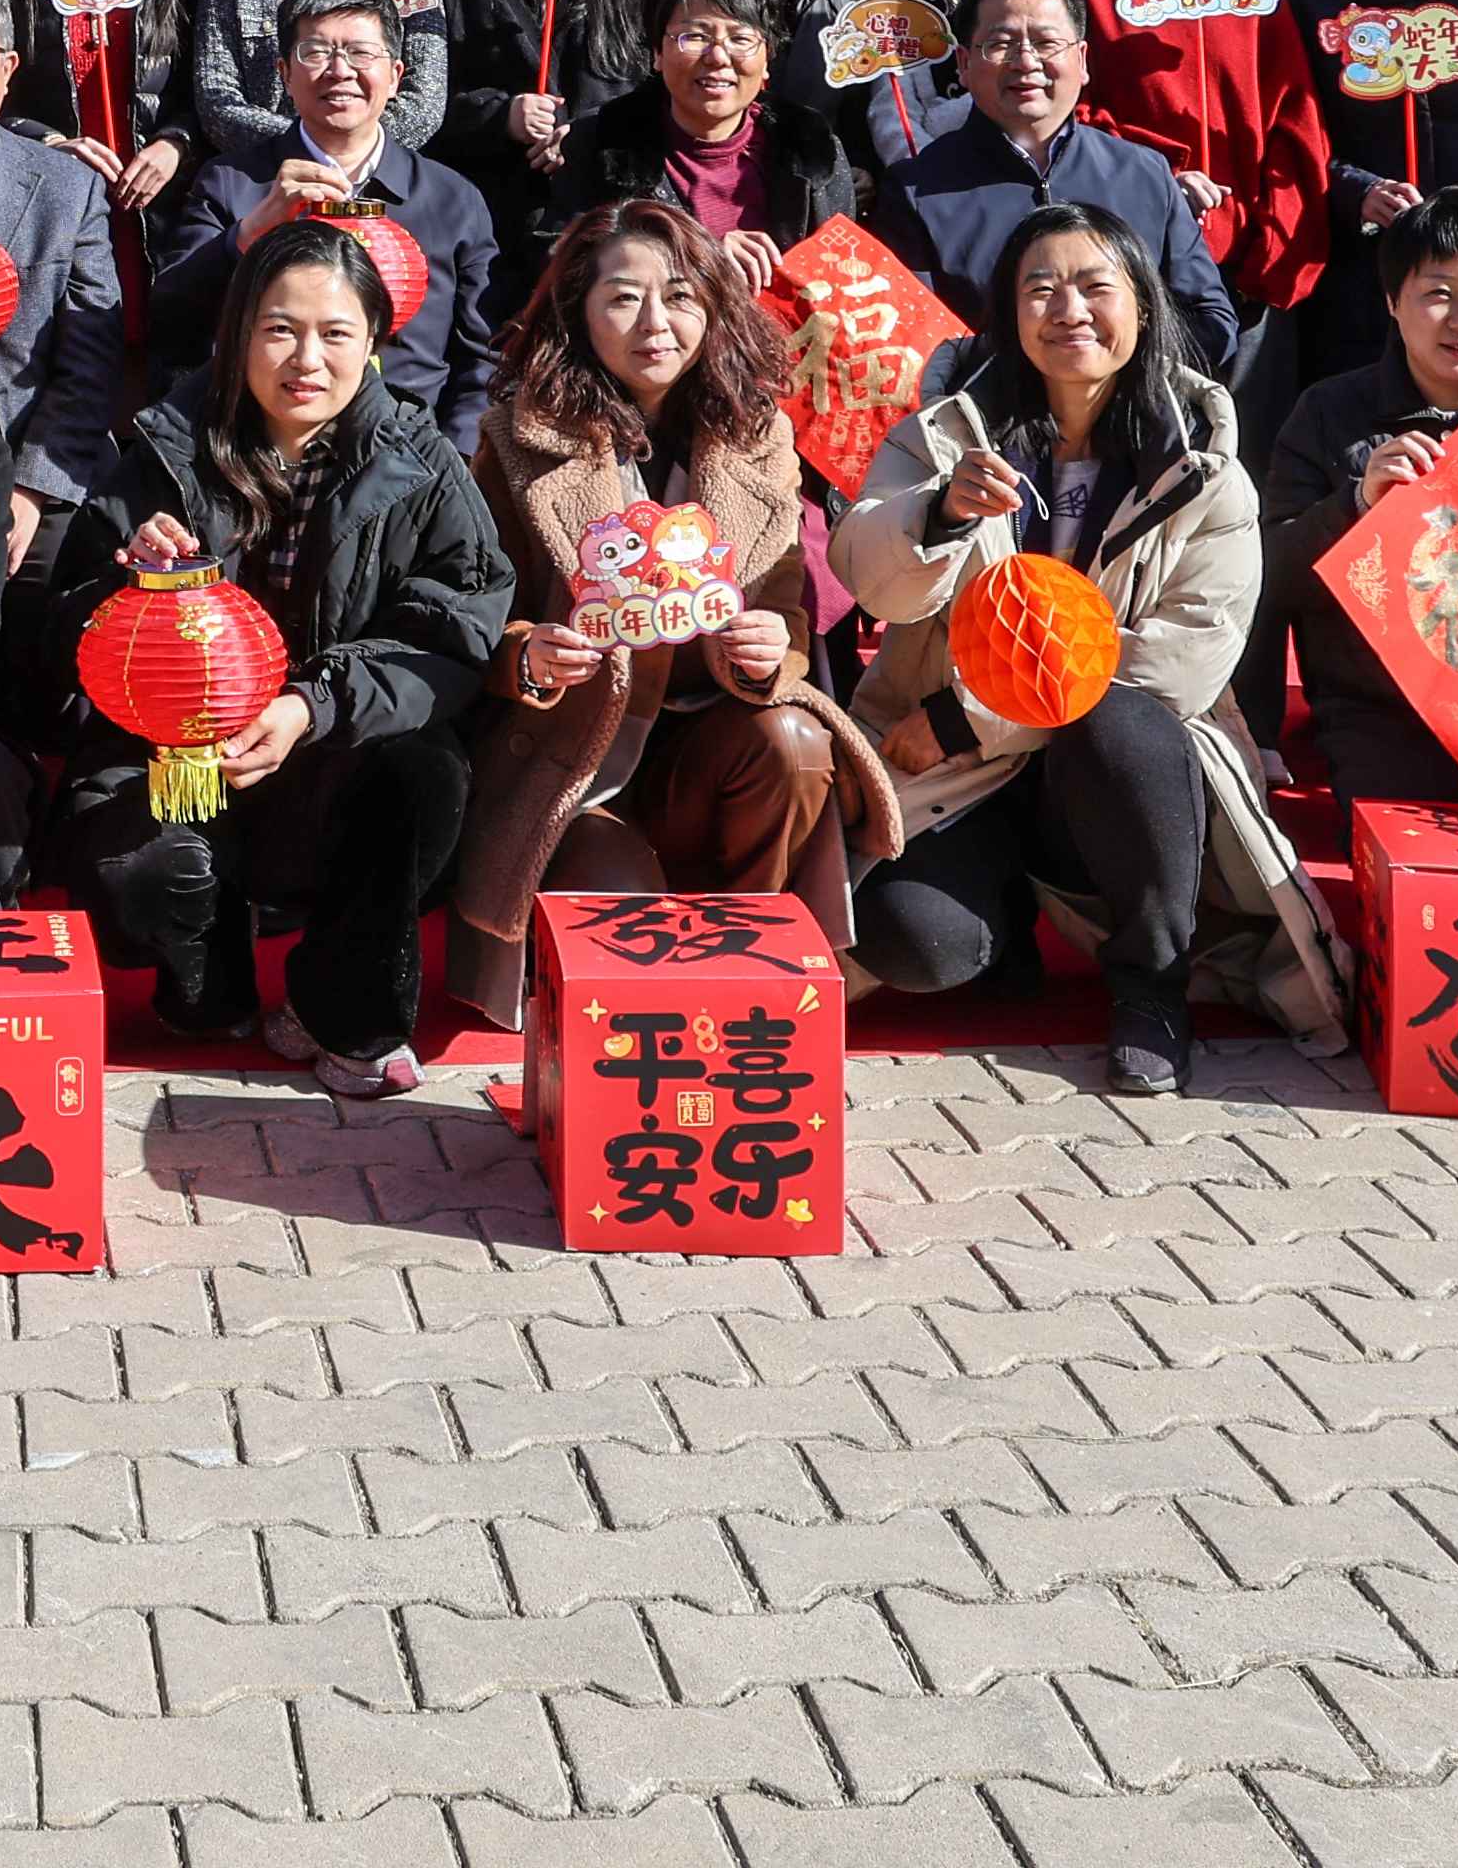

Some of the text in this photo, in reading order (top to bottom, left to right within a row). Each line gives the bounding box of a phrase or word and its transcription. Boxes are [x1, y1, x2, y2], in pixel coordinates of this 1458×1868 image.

[784, 275, 925, 416] 福
[579, 588, 734, 639] 新年快乐
